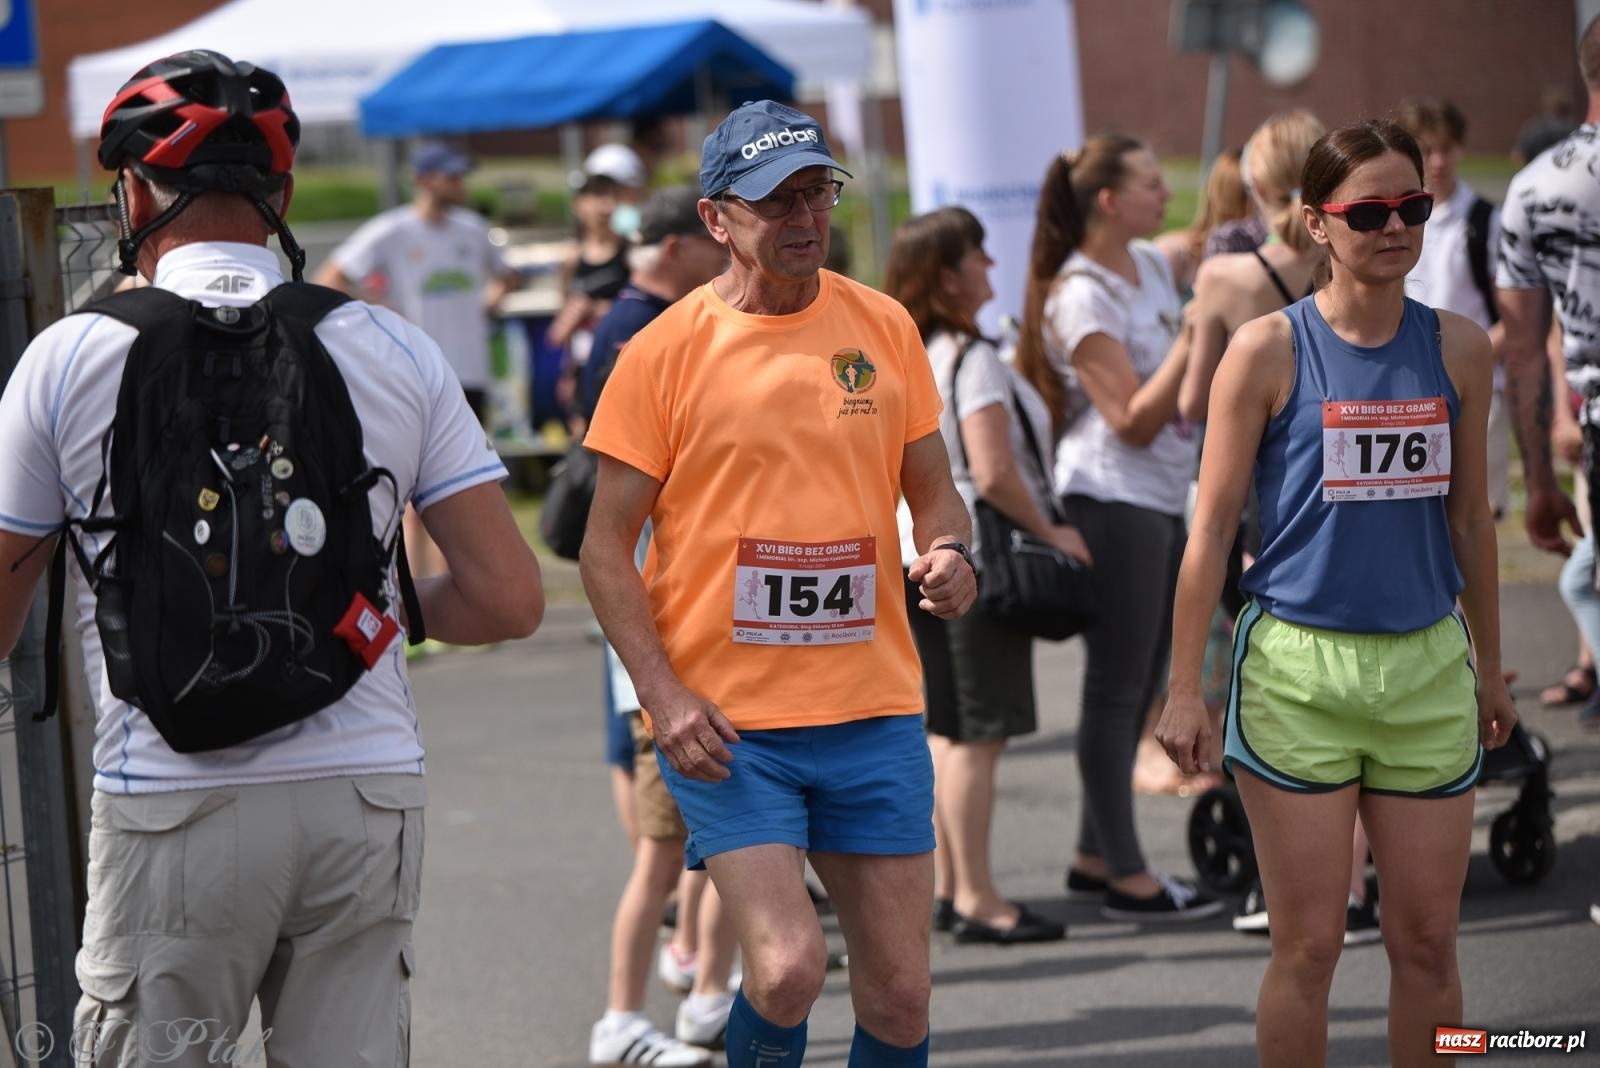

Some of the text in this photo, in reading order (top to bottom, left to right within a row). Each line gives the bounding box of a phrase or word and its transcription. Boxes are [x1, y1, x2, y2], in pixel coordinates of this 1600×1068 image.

[741, 128, 818, 160] adidas
[205, 275, 255, 294] 4F
[1340, 402, 1437, 414] XVI BIEG BEZ GRANIC
[1355, 432, 1427, 474] 176
[756, 542, 861, 556] XVI BIEG BEZ GRANIC
[764, 574, 854, 617] 154
